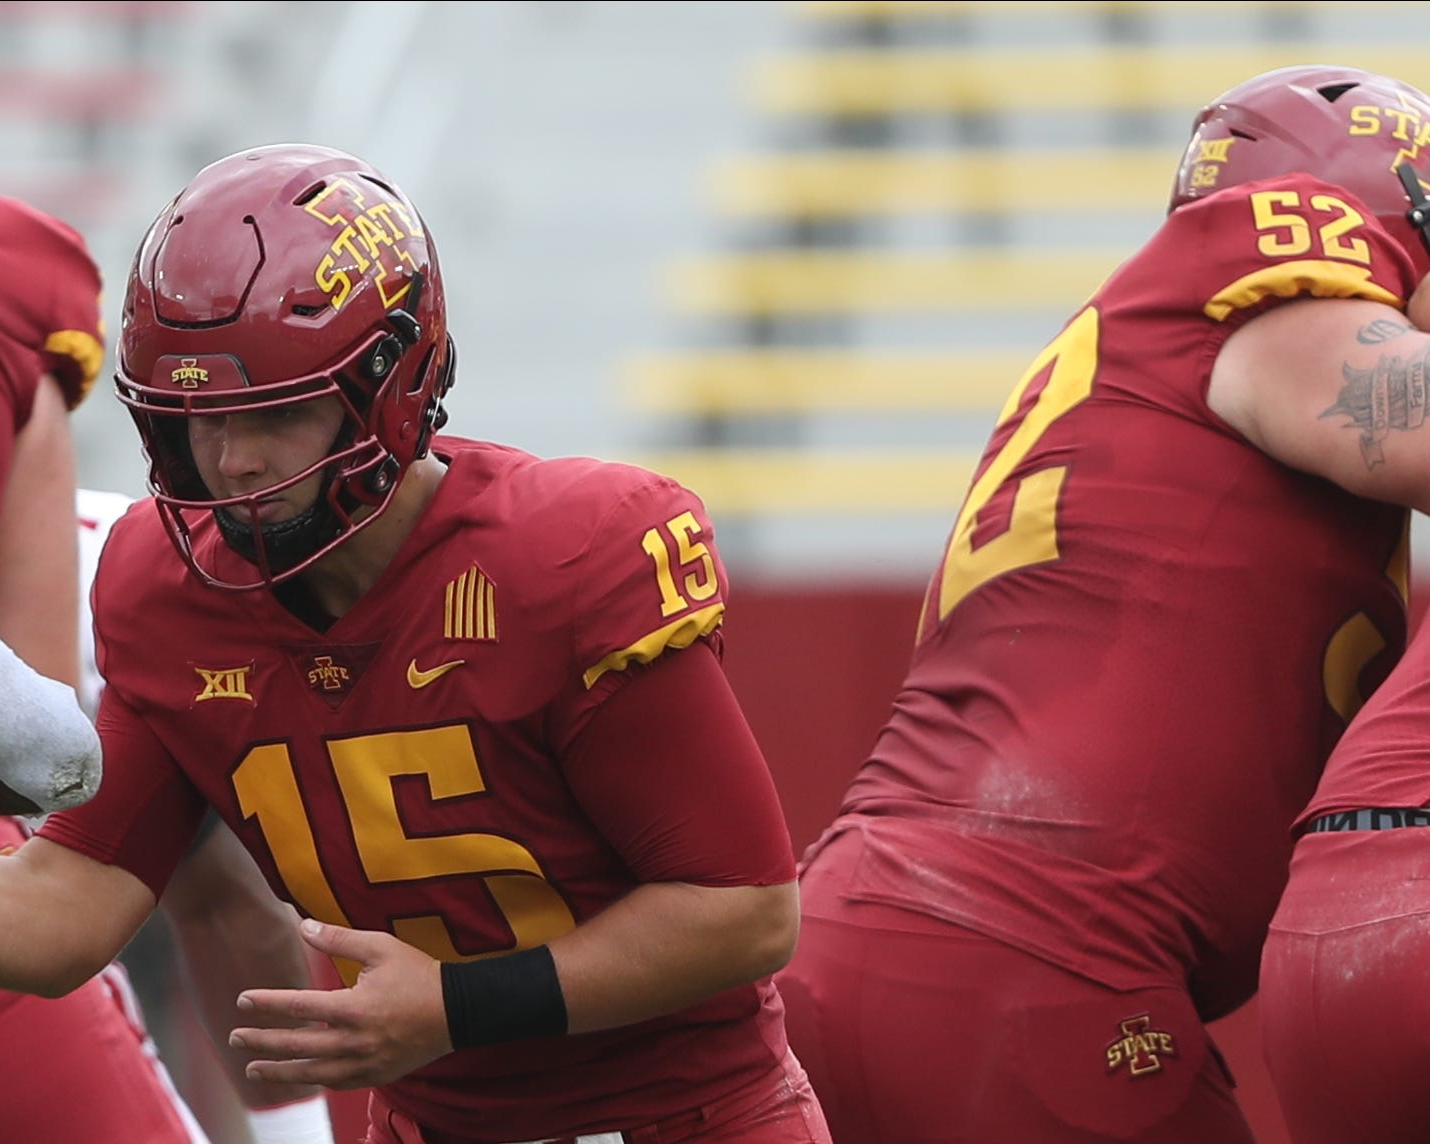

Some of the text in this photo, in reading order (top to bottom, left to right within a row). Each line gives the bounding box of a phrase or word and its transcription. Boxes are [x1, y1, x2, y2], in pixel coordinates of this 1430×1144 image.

[1195, 137, 1235, 163] XII
[1191, 165, 1218, 188] 52
[1250, 191, 1371, 265] 52
[315, 200, 426, 311] STATE
[172, 367, 209, 383] STATE
[641, 510, 718, 617] 15
[194, 666, 253, 701] XII
[308, 665, 349, 684] STATE
[230, 724, 576, 988] 15
[1107, 1032, 1173, 1067] STATE
